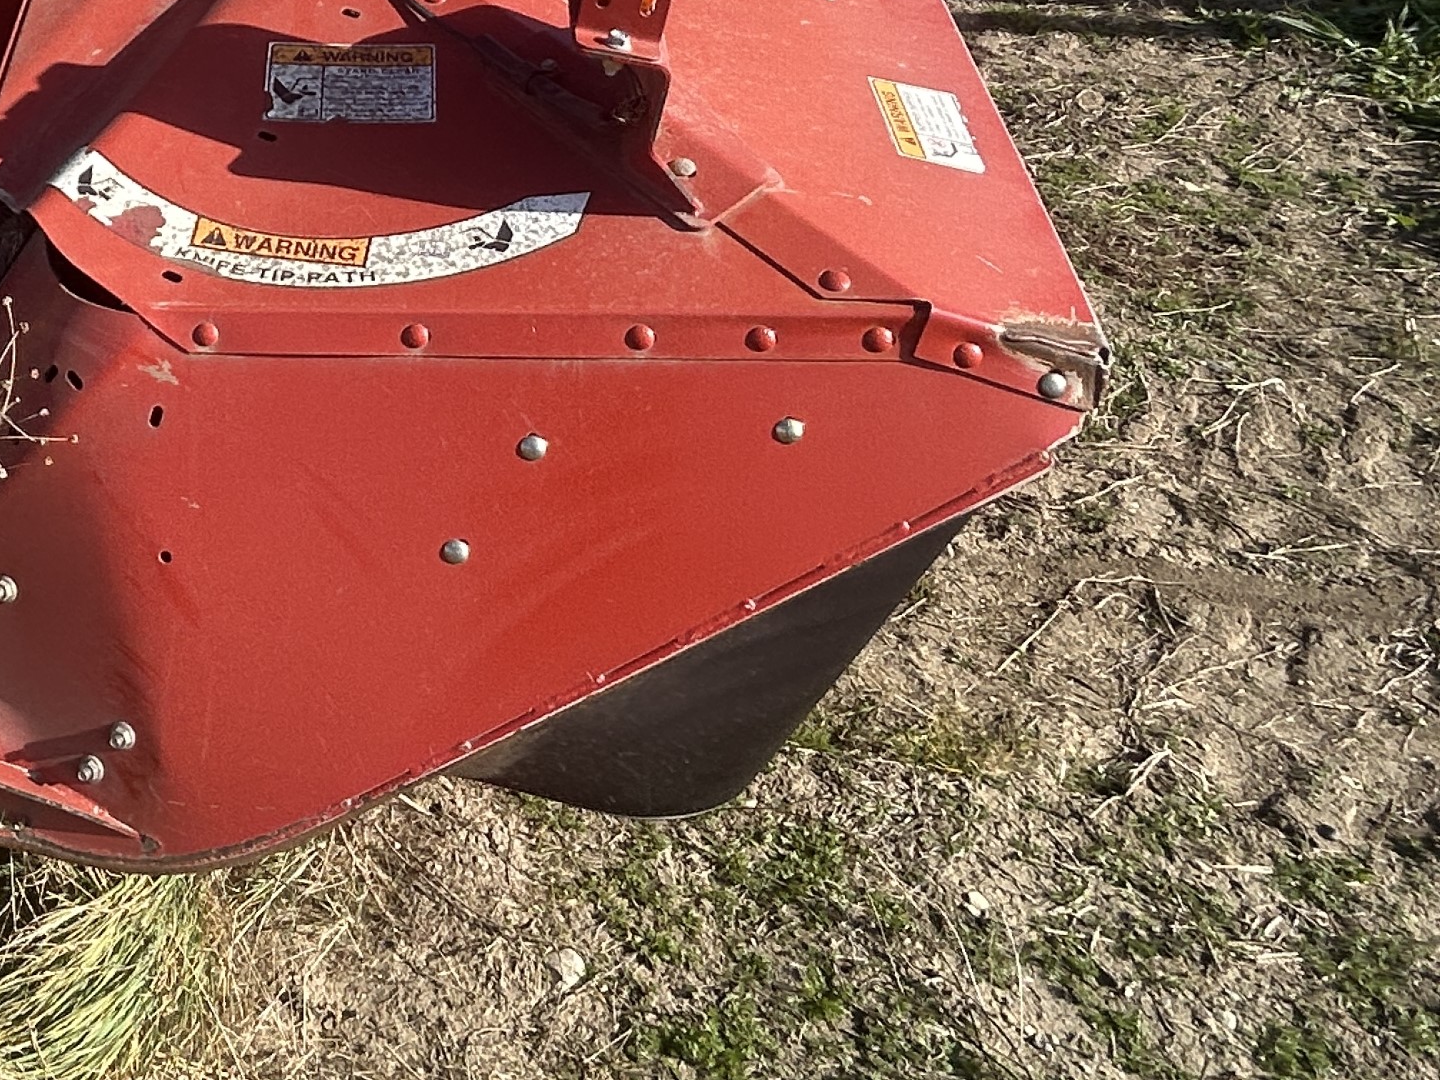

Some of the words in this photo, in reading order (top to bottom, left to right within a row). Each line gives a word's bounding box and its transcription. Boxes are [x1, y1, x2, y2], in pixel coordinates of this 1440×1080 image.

[322, 51, 414, 63] WARNING
[233, 232, 361, 261] WARNING
[175, 246, 246, 276] KNIFE
[259, 268, 294, 282] TIP
[309, 271, 377, 284] PATH
